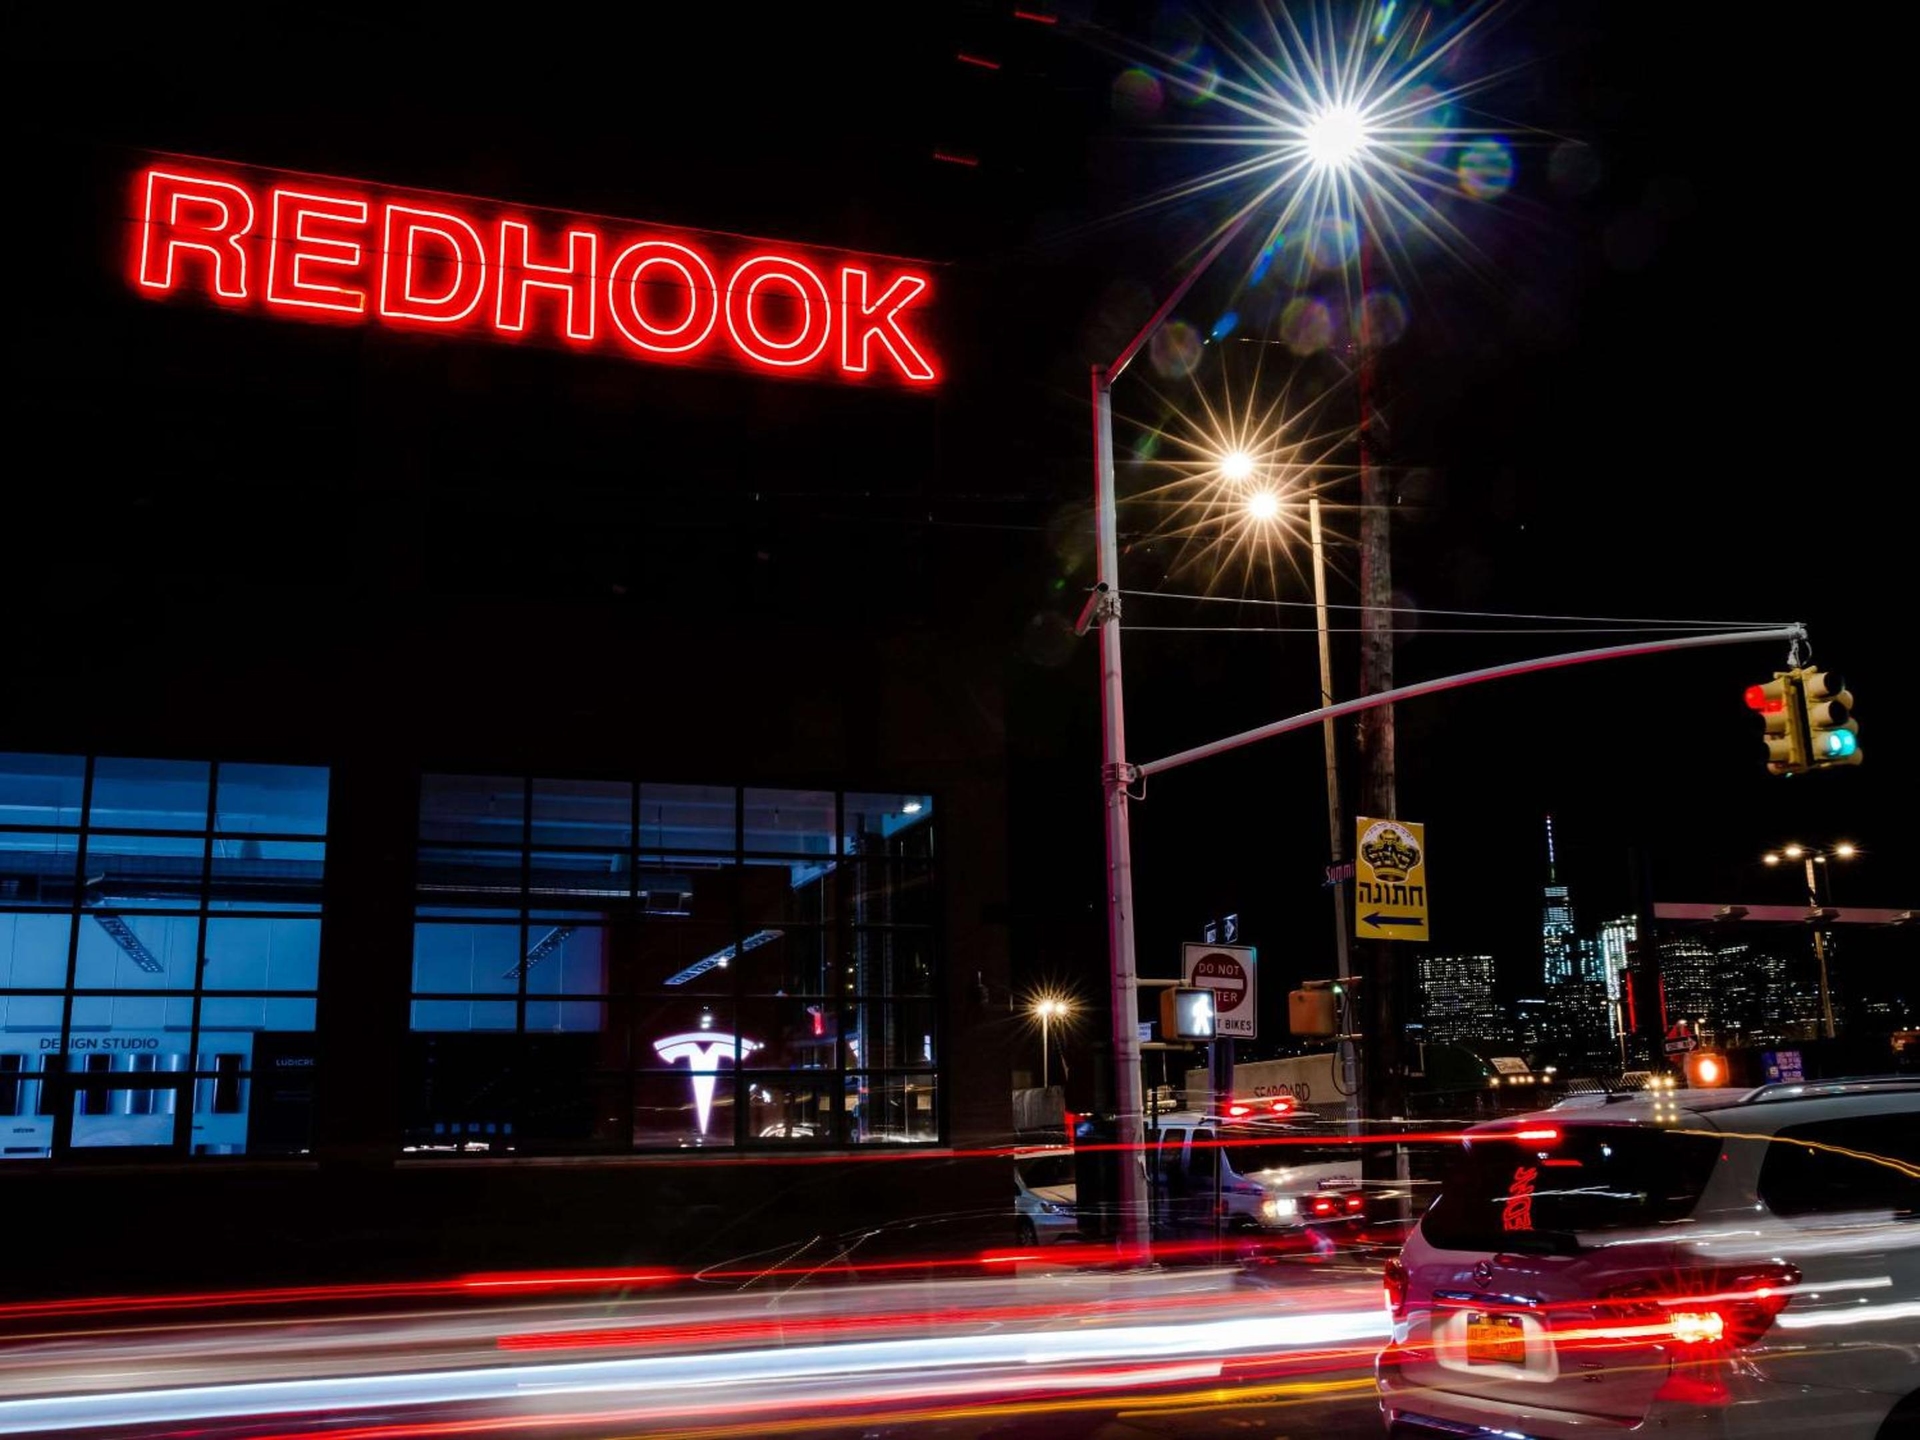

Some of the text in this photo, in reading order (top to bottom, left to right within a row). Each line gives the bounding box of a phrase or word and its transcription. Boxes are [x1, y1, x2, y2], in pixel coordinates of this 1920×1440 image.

[137, 168, 937, 382] REDHOOK
[1325, 859, 1356, 883] Summi
[1358, 881, 1424, 907] חתונה
[1198, 962, 1240, 976] DO NOT
[1216, 991, 1238, 1002] TER
[1225, 1019, 1252, 1031] BIKES
[40, 1037, 159, 1049] DEIGN STUDIO
